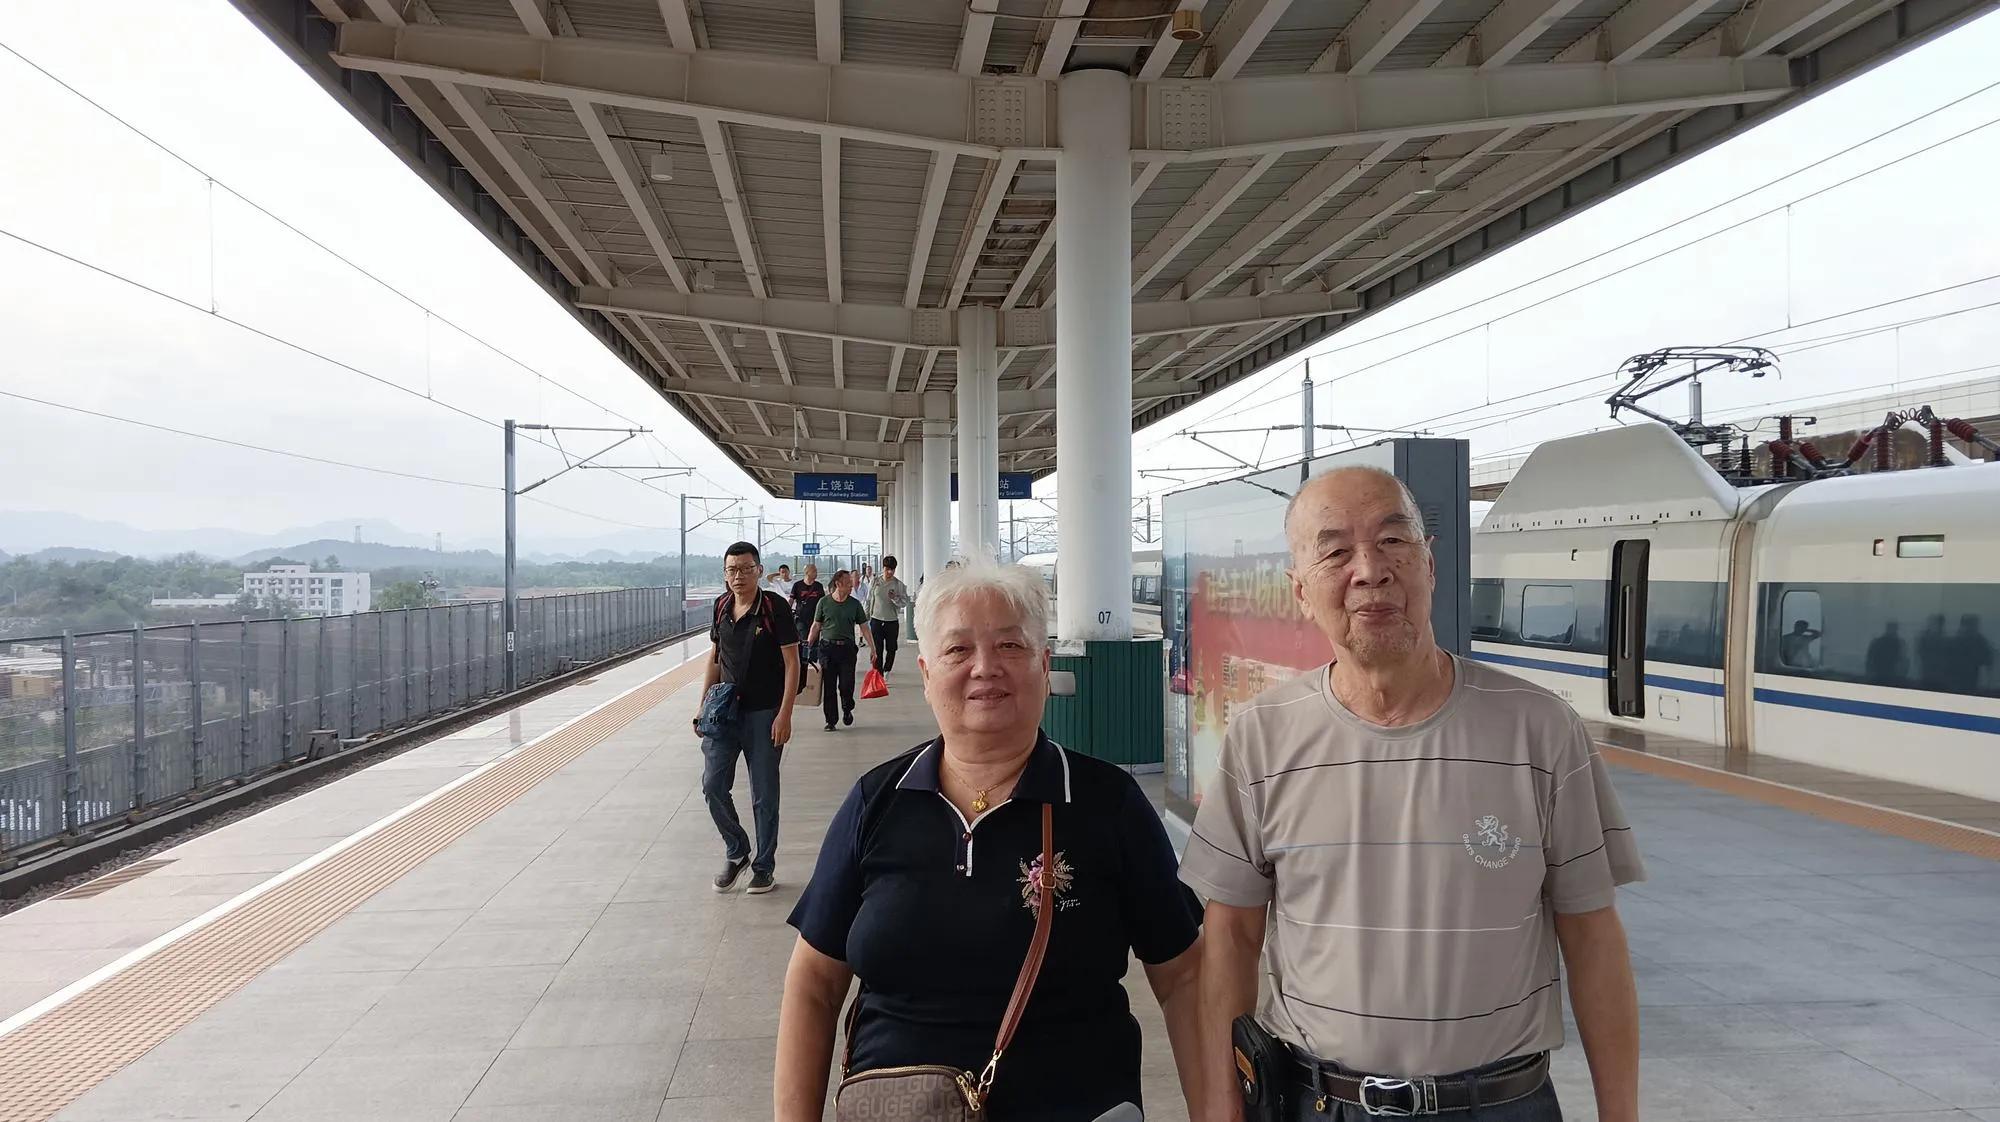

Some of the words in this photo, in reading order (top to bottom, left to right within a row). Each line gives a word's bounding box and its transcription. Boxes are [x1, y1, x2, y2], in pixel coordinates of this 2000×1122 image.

[817, 479, 855, 491] 上饶站
[829, 491, 850, 499] Railway
[1098, 610, 1112, 625] 07
[1474, 854, 1509, 870] CHANGE
